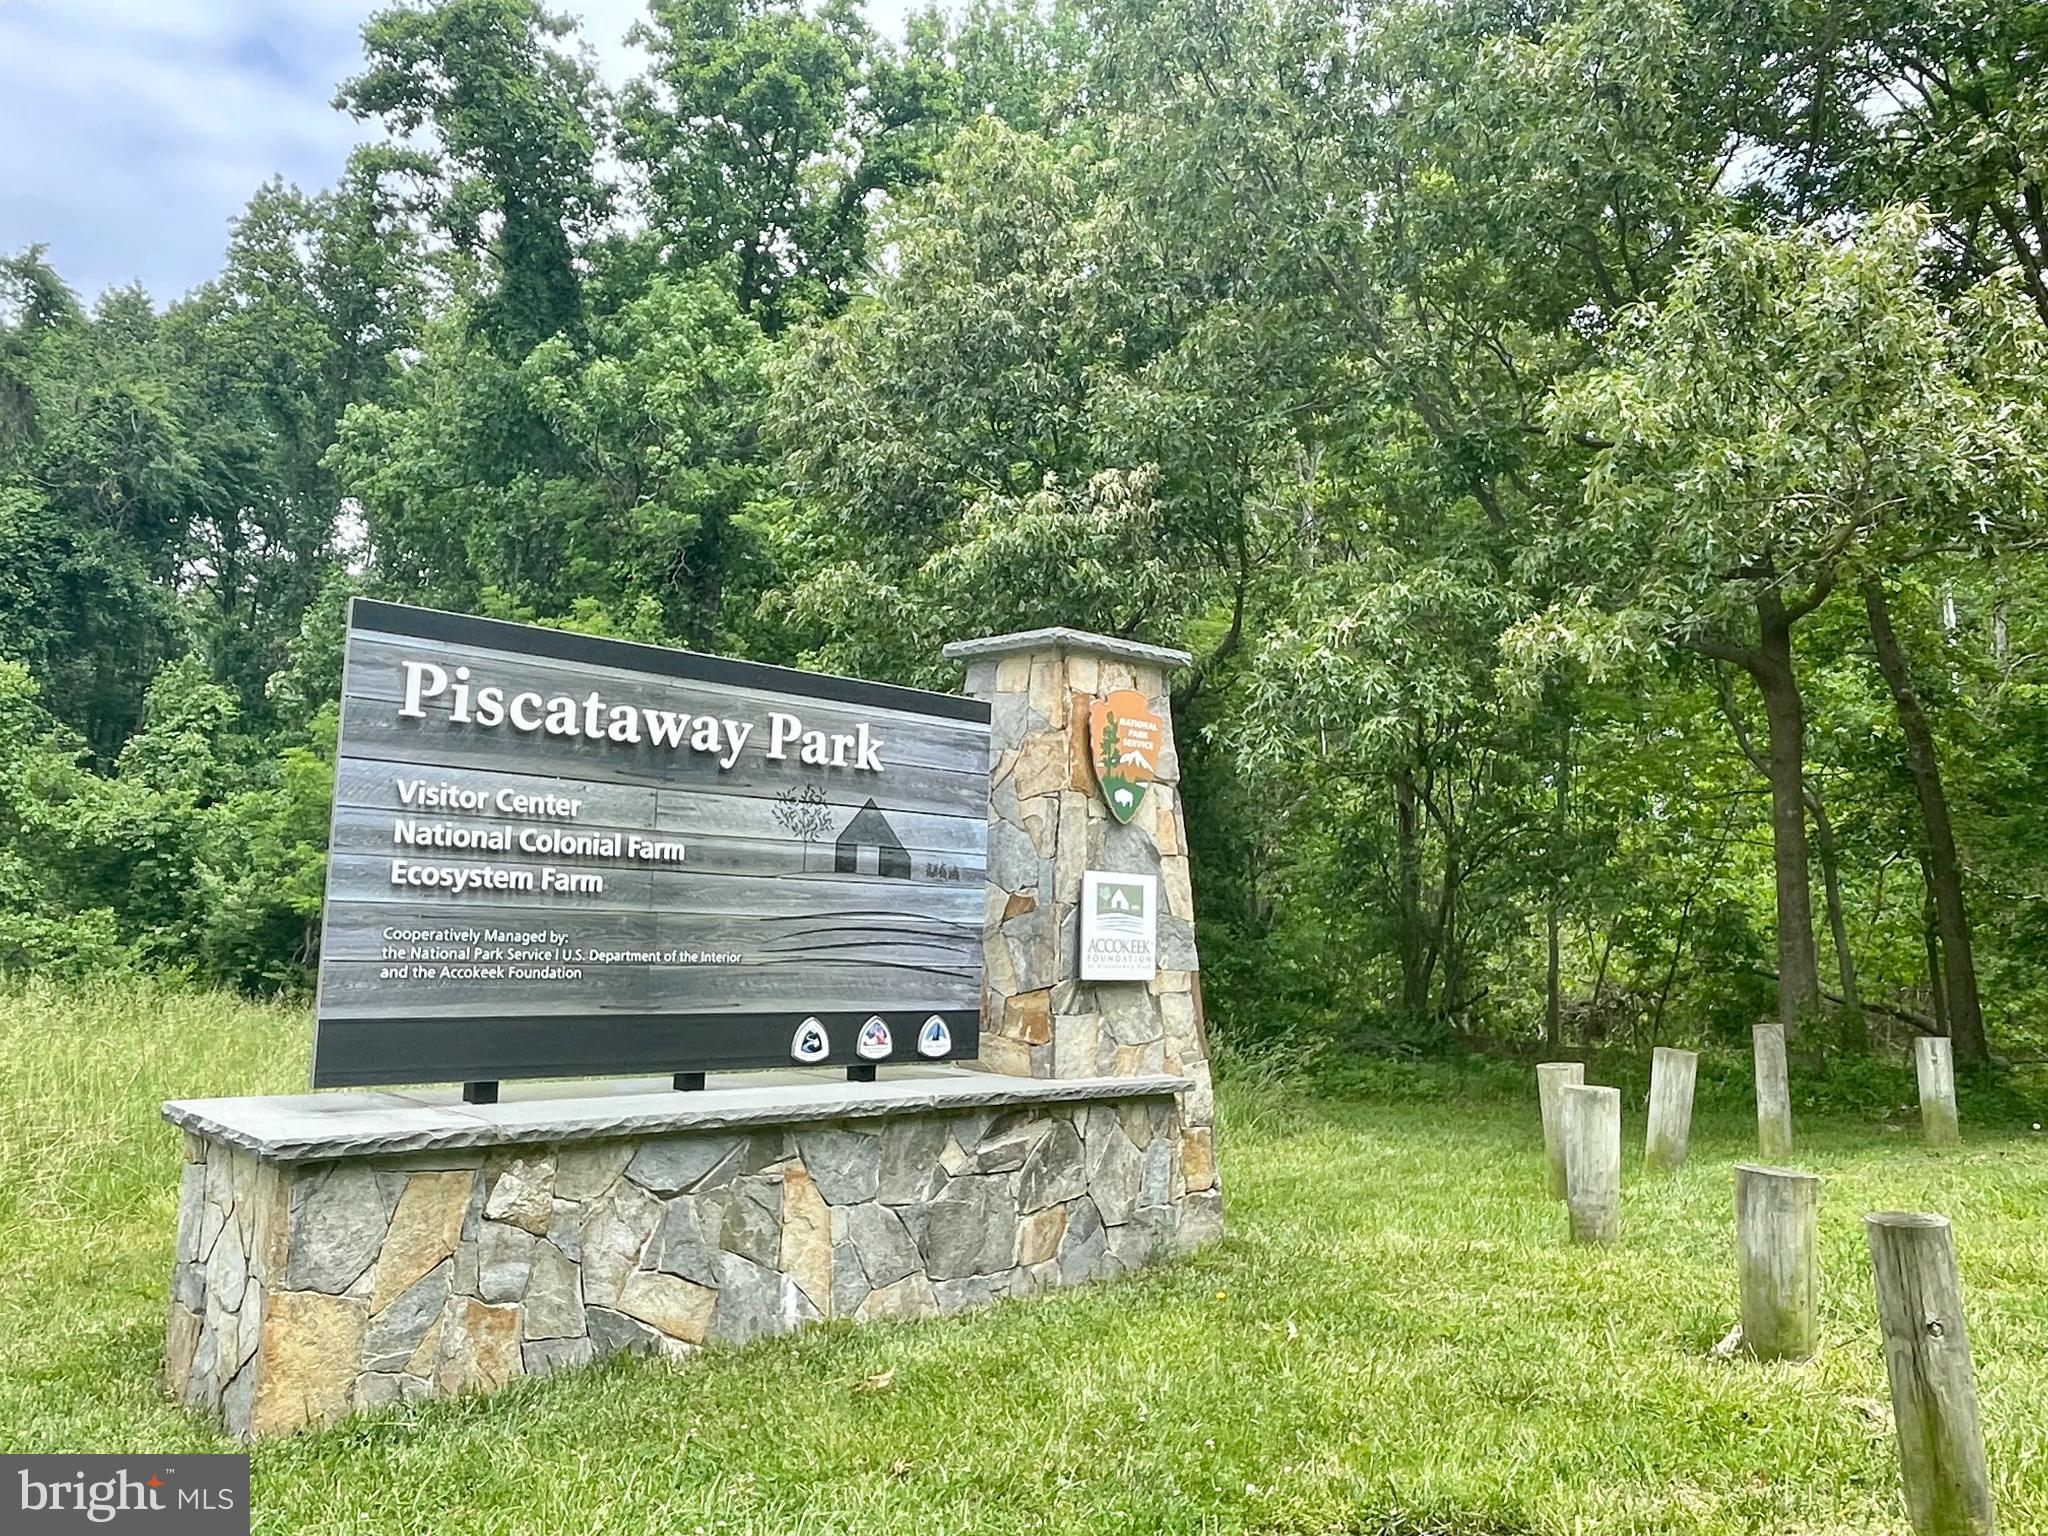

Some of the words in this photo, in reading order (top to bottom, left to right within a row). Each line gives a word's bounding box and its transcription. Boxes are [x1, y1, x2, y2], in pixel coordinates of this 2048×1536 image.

[398, 661, 754, 770] Piscataway
[766, 711, 884, 772] Park
[1119, 717, 1158, 731] NATIONAL
[1128, 729, 1148, 740] PARK
[1122, 738, 1154, 751] SERVICE
[396, 779, 490, 810] Visitor
[495, 788, 582, 817] Center
[393, 819, 513, 851] National
[519, 828, 622, 858] Colonial
[628, 835, 686, 861] Farm
[391, 859, 534, 893] Ecosystem
[541, 867, 603, 893] Farm
[382, 926, 481, 945] Cooperatively
[484, 928, 546, 946] Managed
[549, 930, 569, 946] by:
[1088, 937, 1151, 954] ACCOKEEK
[382, 946, 407, 960] the
[410, 946, 470, 961] National
[474, 947, 503, 961] Park
[507, 947, 553, 961] Service
[562, 948, 586, 962] U.S.
[589, 949, 661, 964] Department
[663, 949, 677, 962] of
[679, 950, 698, 963] the
[701, 950, 742, 963] Interior
[1087, 954, 1152, 963] FOUNDATION
[380, 965, 408, 979] and
[412, 965, 436, 979] the
[439, 965, 505, 979] Accokeek
[508, 965, 583, 980] Foundation
